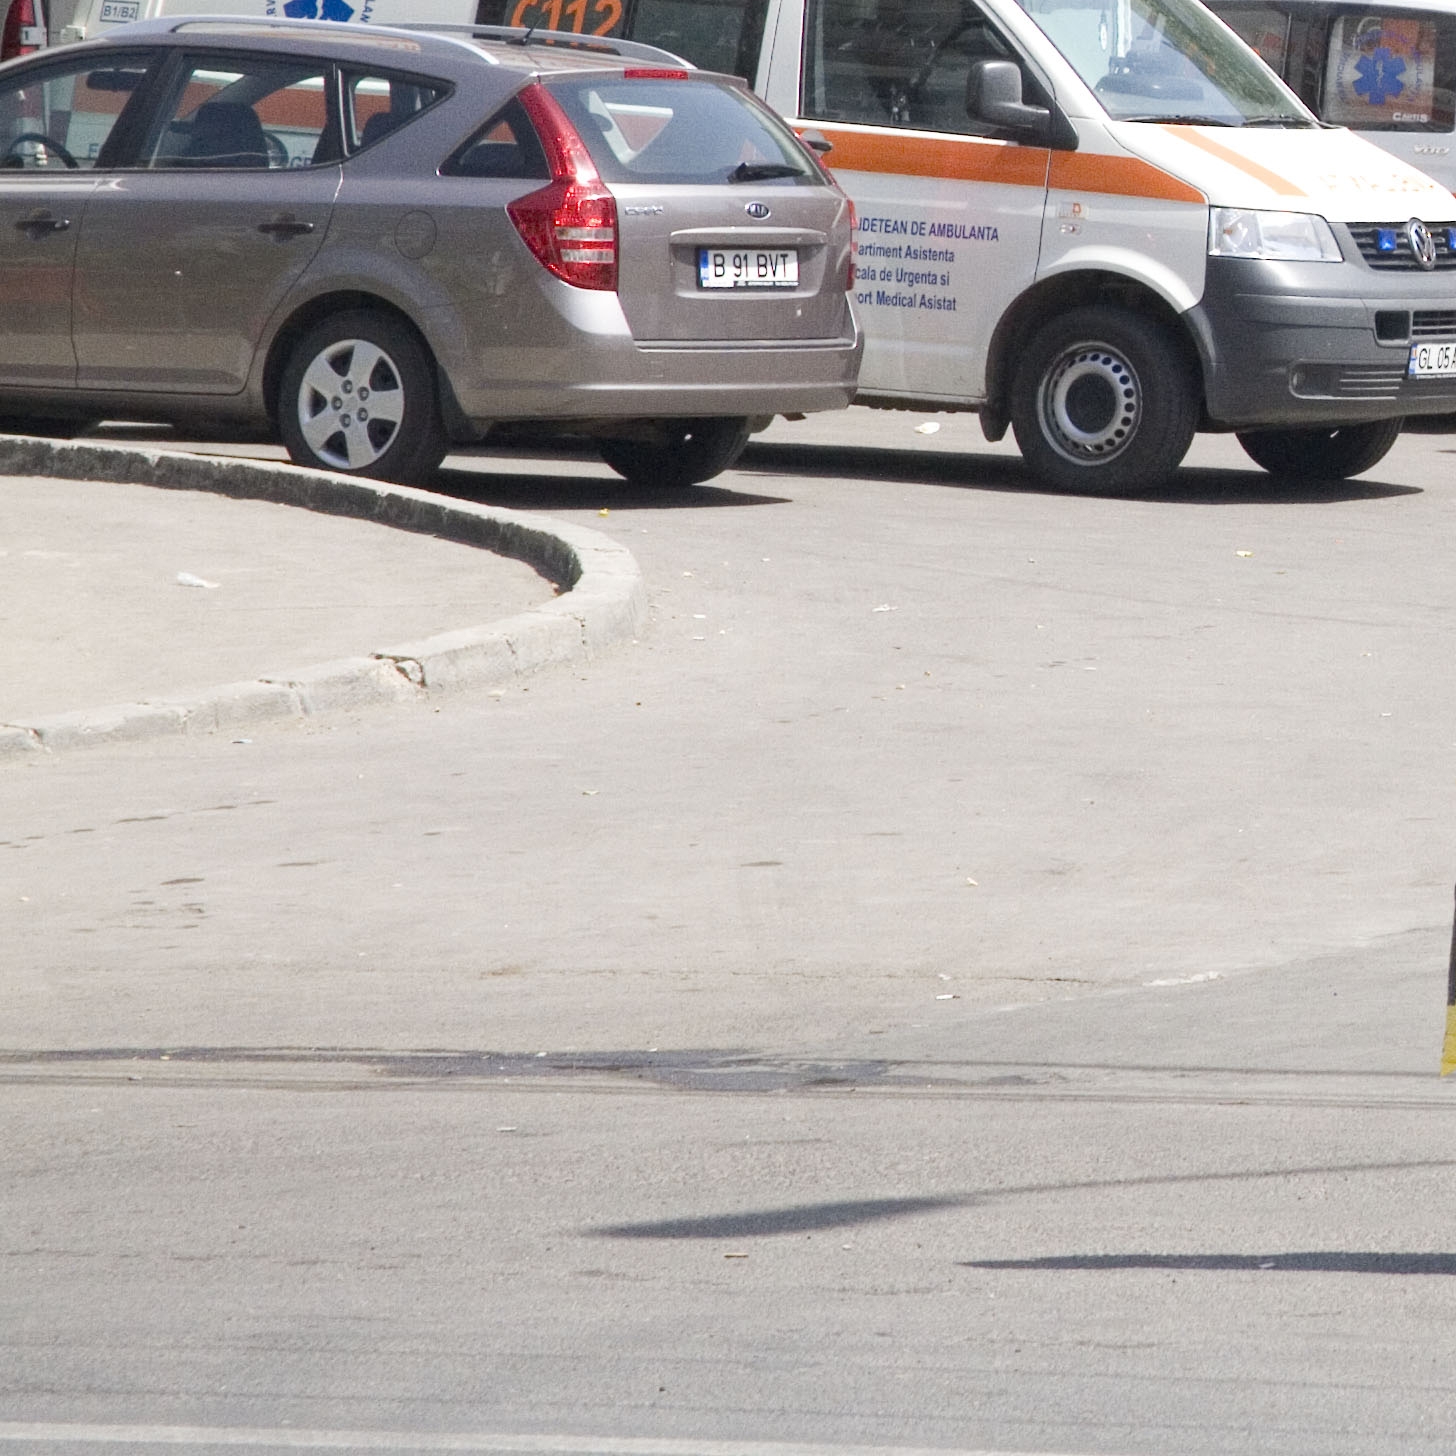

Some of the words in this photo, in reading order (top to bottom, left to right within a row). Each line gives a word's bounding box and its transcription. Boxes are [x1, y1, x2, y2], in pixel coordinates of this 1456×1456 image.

[911, 221, 927, 237] DE
[928, 223, 999, 242] AMBULANTA
[904, 245, 955, 263] Asistenta
[713, 253, 725, 278] B
[733, 253, 748, 278] 91
[756, 253, 789, 278] BVT
[879, 267, 892, 282] de
[895, 268, 938, 288] Urgenta
[939, 271, 950, 286] si
[856, 292, 873, 306] ort
[876, 291, 917, 309] Medical
[919, 294, 957, 312] Asistat
[1418, 347, 1433, 370] GL
[1437, 346, 1450, 369] 05
